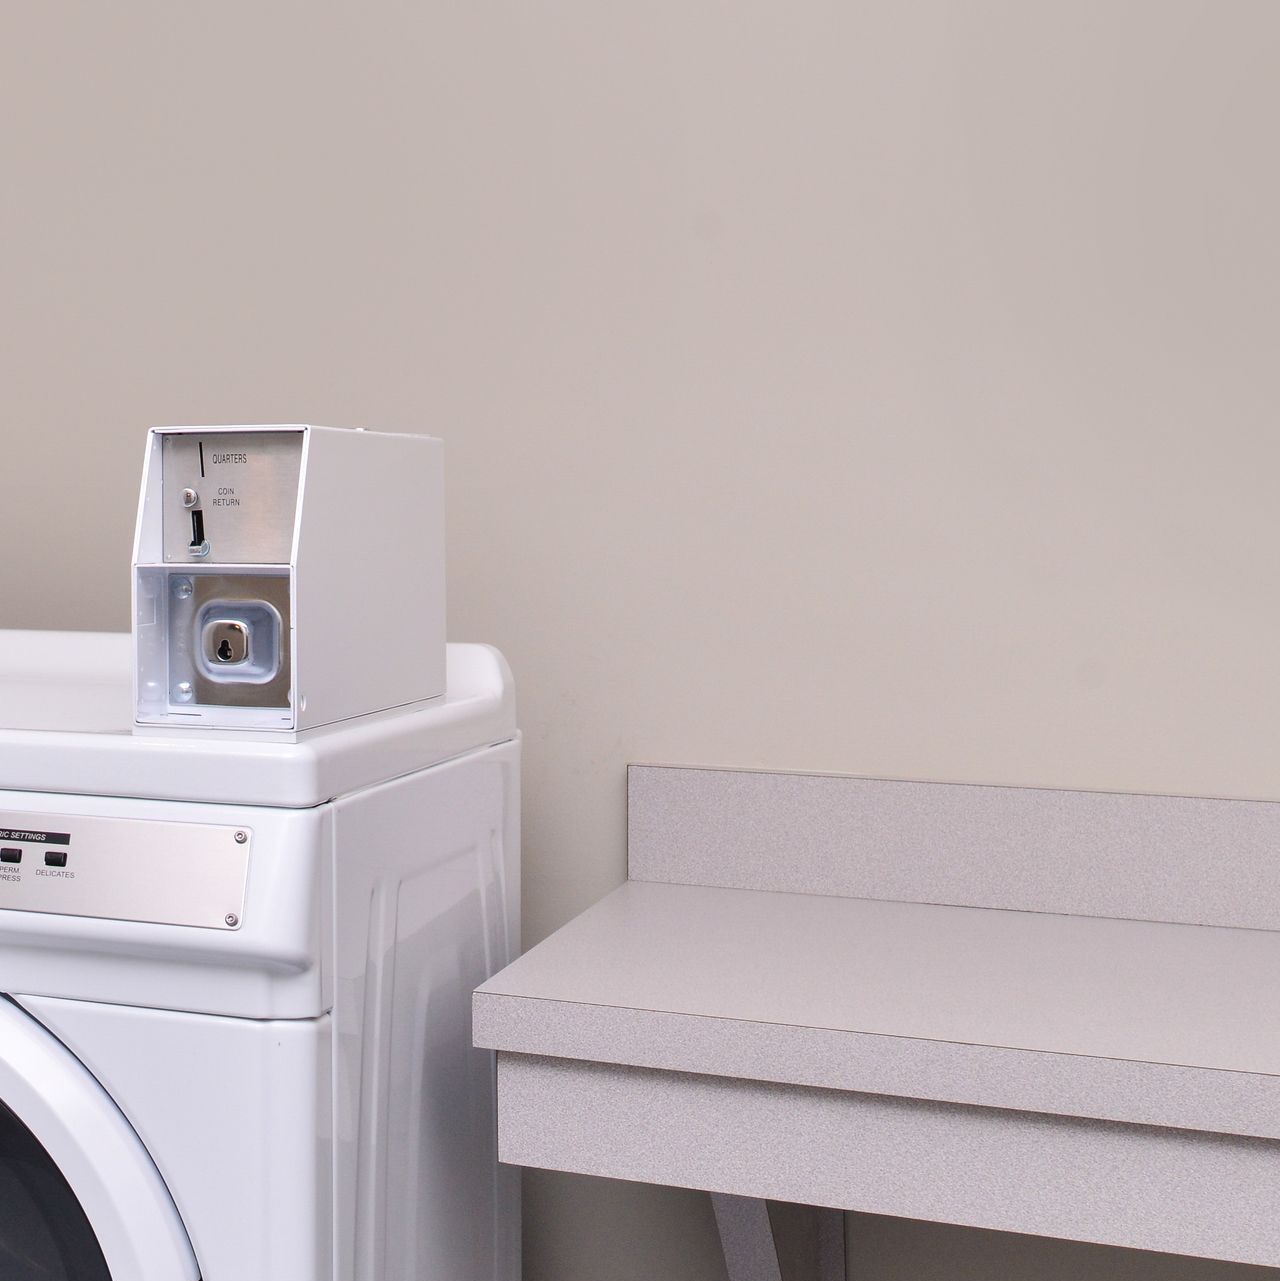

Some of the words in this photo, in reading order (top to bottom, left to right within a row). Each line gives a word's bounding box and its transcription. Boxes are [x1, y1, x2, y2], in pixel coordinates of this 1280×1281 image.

[212, 454, 247, 464] QUARTERS
[218, 487, 234, 495] COIN
[10, 831, 46, 841] SETTINGS
[35, 869, 75, 879] DELICATES
